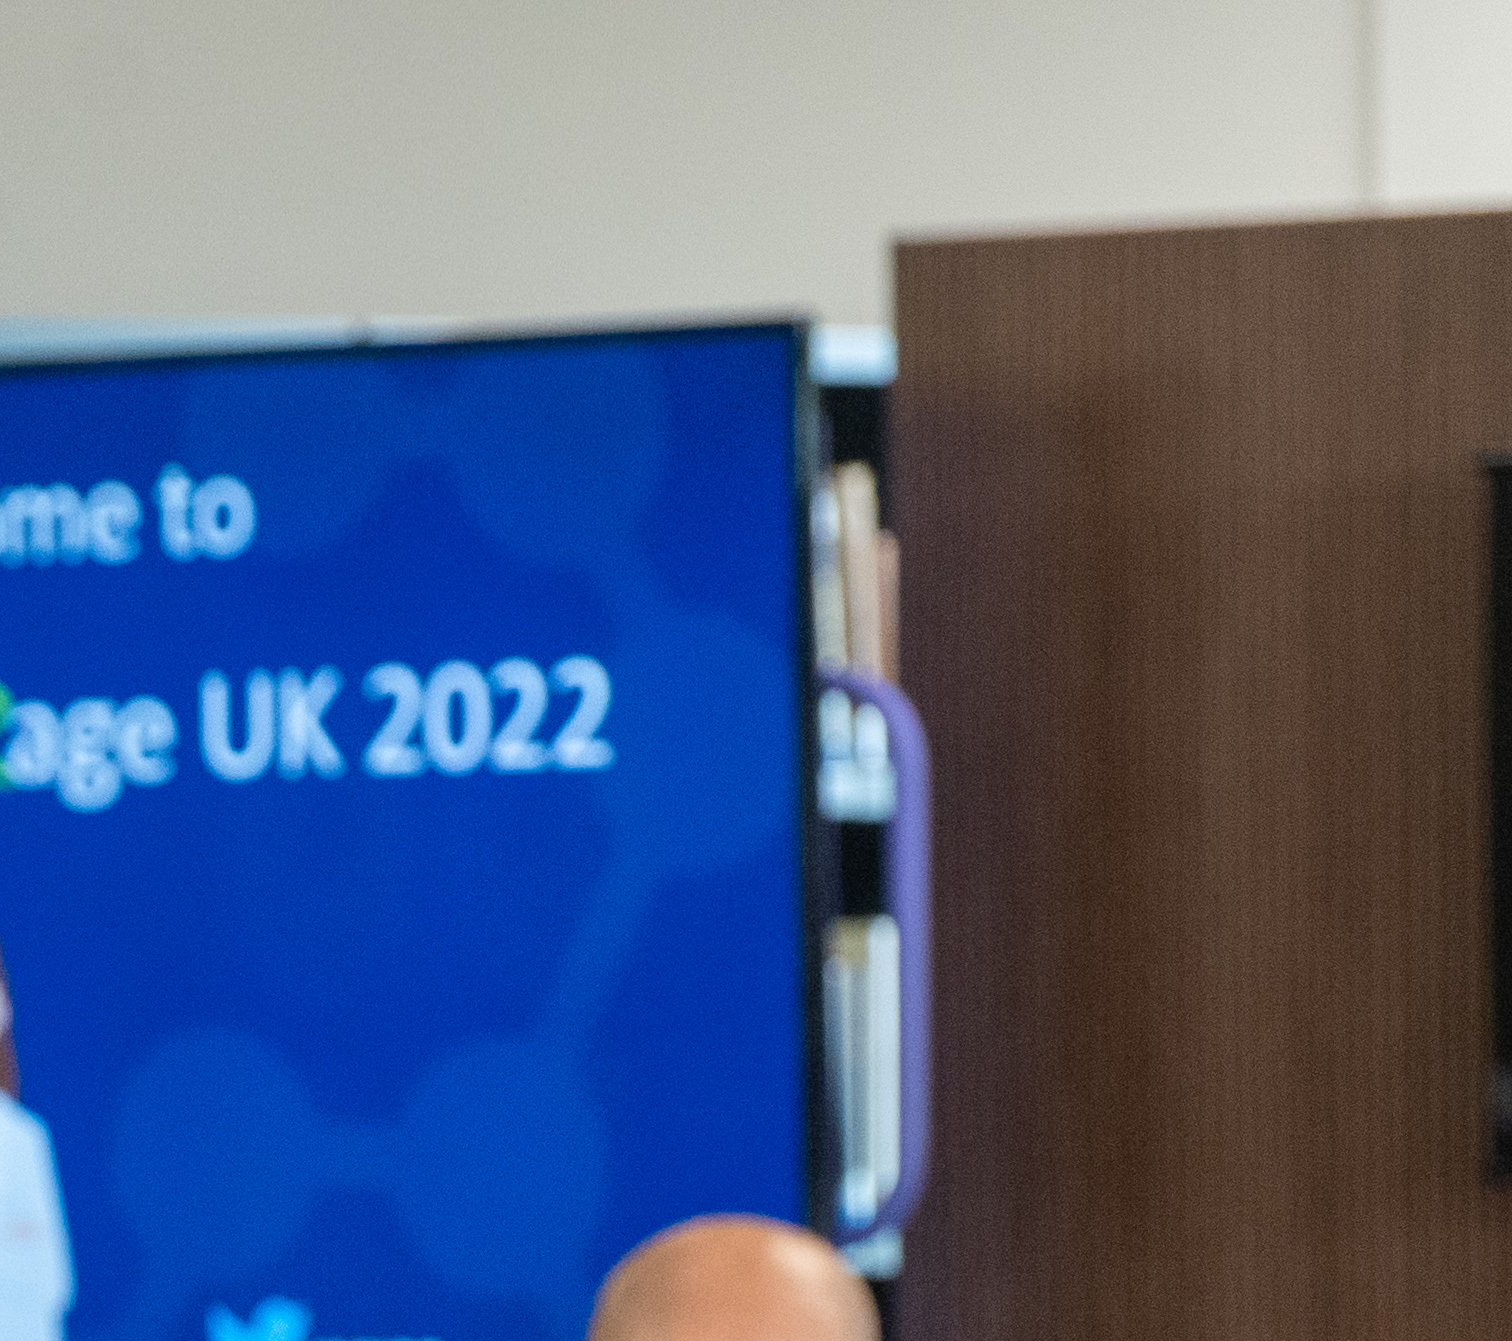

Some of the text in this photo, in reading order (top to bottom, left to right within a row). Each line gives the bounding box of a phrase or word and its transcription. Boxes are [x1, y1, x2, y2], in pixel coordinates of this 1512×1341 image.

[156, 463, 256, 561] to
[199, 665, 344, 783] UK
[363, 654, 615, 778] 2022
